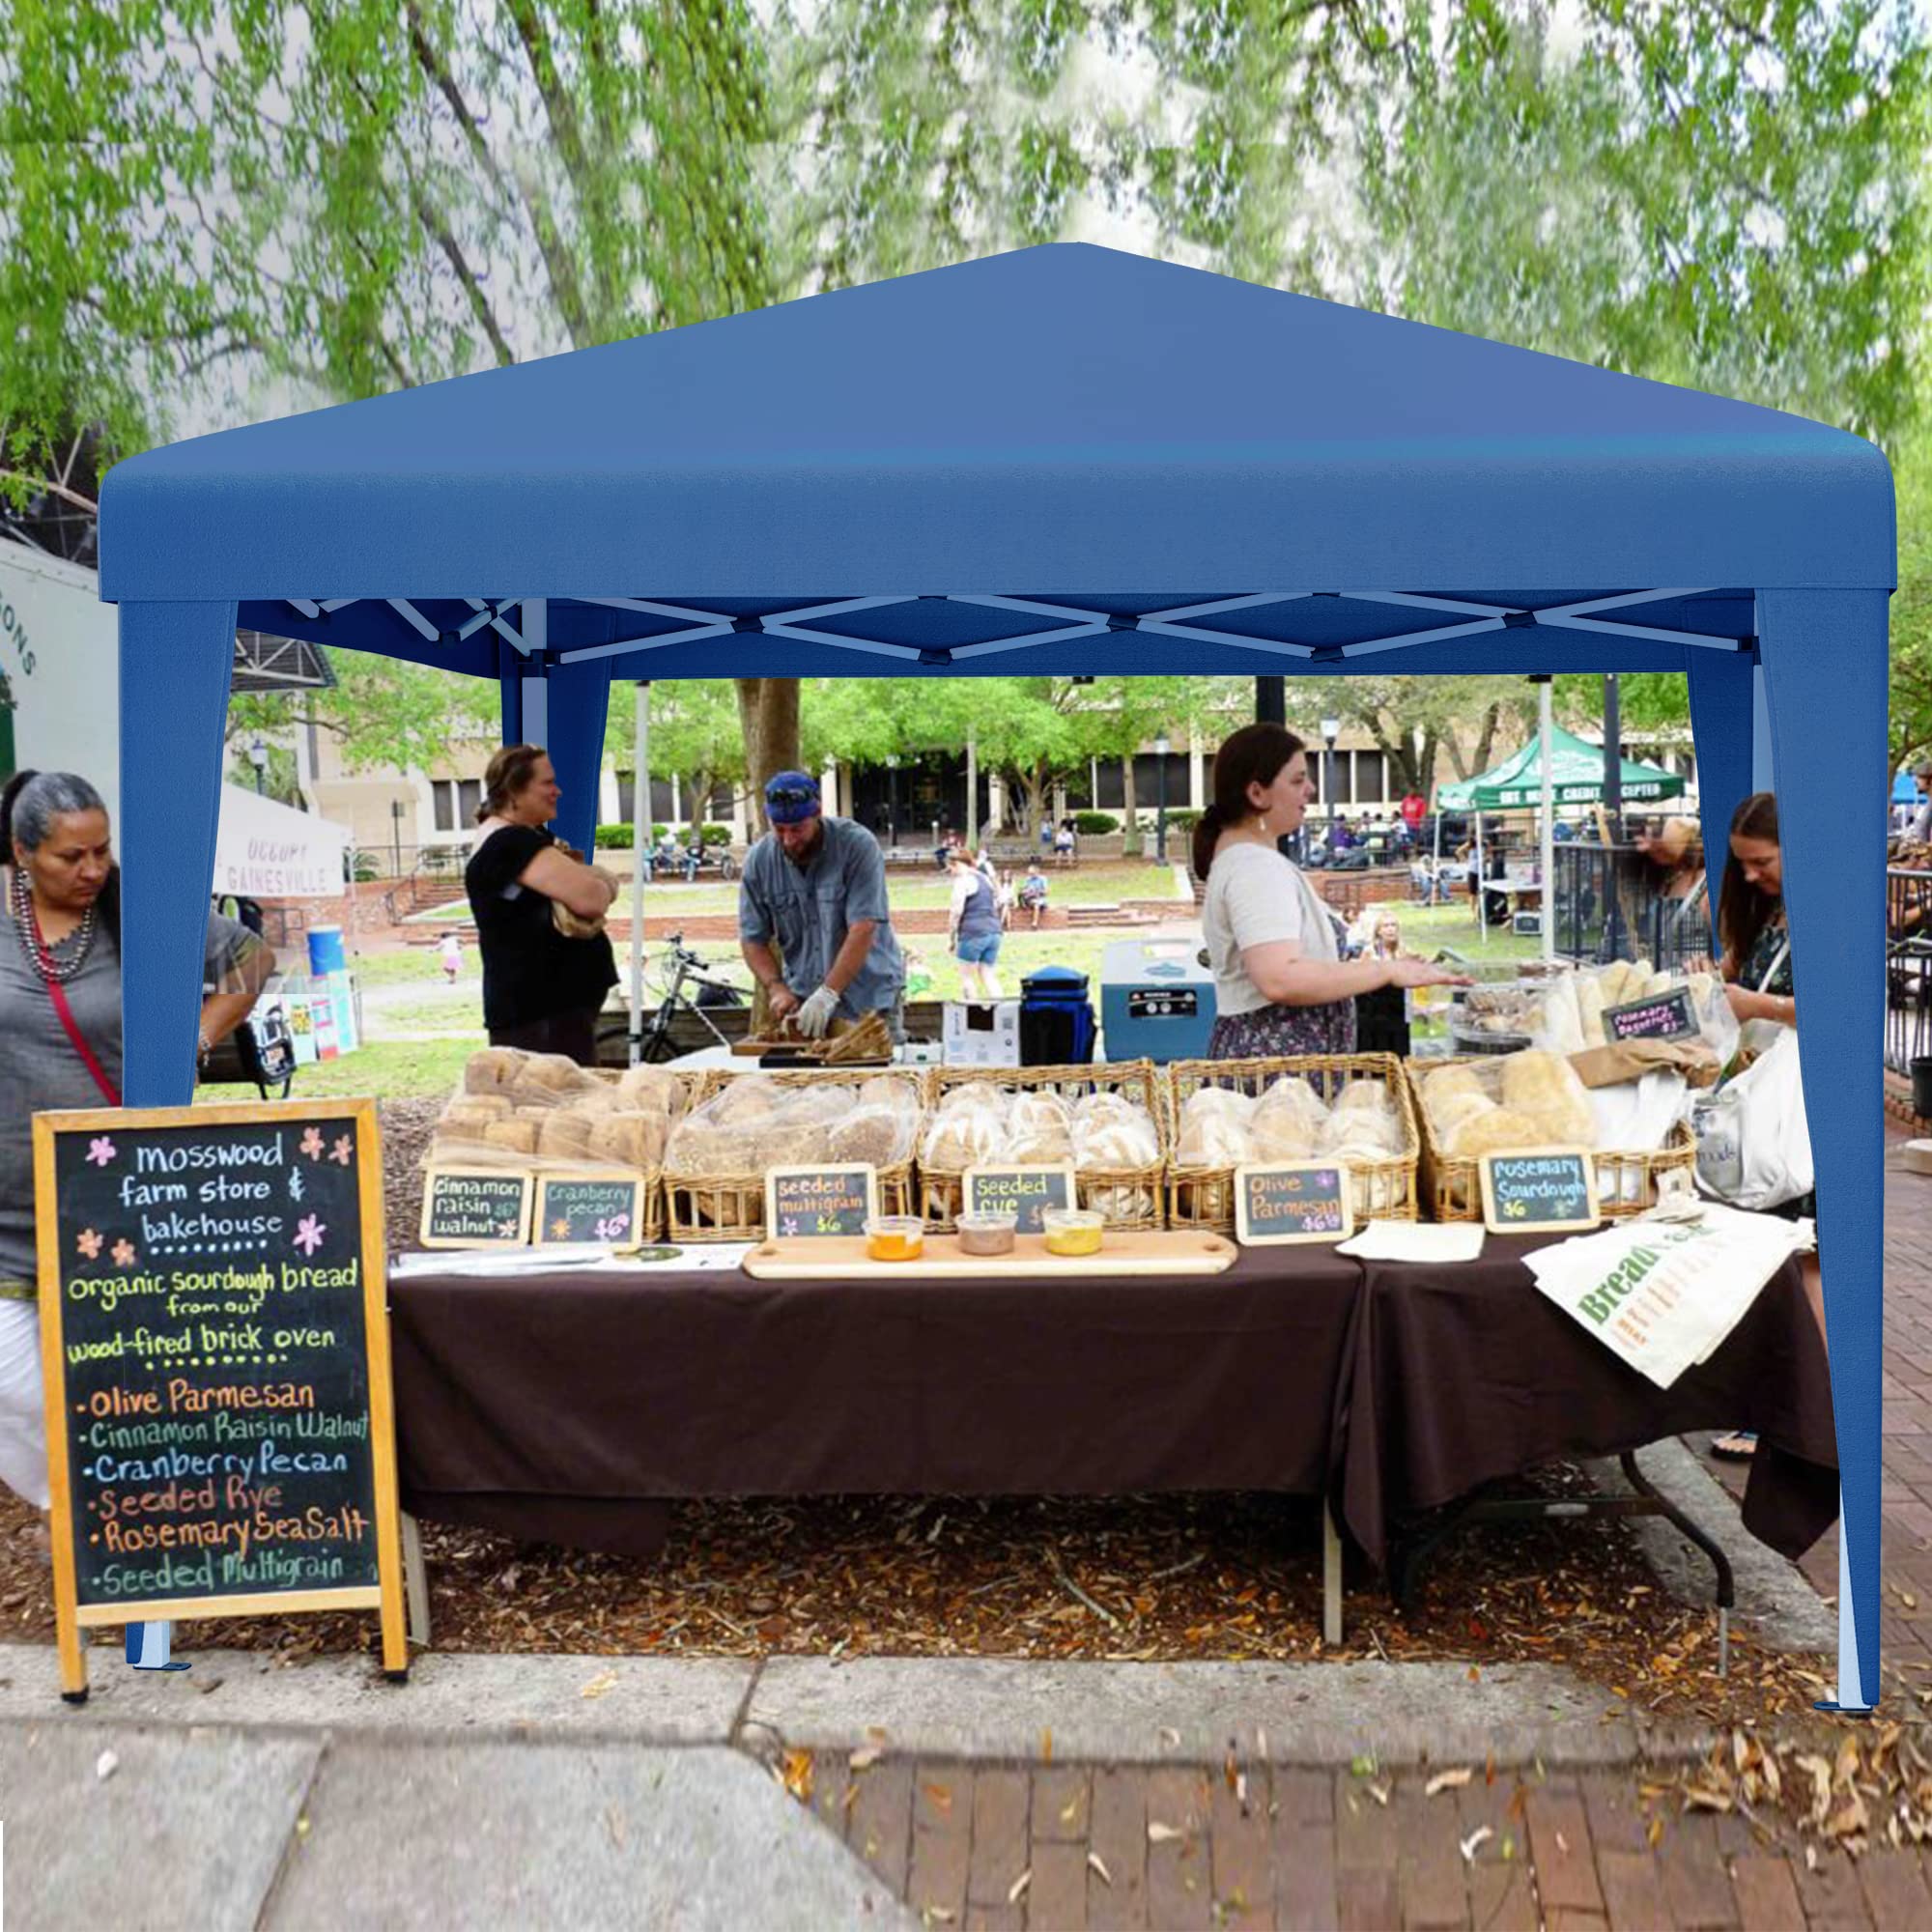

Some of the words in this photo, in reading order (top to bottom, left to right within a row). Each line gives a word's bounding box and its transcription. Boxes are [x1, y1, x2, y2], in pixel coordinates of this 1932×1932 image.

[0, 591, 36, 676] ONS
[1621, 782, 1661, 798] CEPTED
[247, 838, 307, 863] OCCUPY
[227, 867, 327, 893] GAINESVILLE
[137, 1132, 283, 1173] mosswood
[119, 1176, 187, 1208] farm
[199, 1174, 270, 1203] store
[1251, 1174, 1302, 1194] Olive
[437, 1197, 491, 1215] raisin
[566, 1204, 616, 1220] pecan
[1252, 1195, 1339, 1219] Parmesan
[142, 1211, 282, 1242] bakehouse
[435, 1215, 497, 1234] walnut
[816, 1215, 841, 1233] $6
[68, 1271, 165, 1311] organic
[173, 1263, 274, 1303] sourdough
[281, 1259, 357, 1292] bread
[1577, 1243, 1663, 1325] Bread
[166, 1296, 220, 1317] from
[225, 1298, 264, 1314] our
[68, 1325, 190, 1364] wood-fired
[201, 1323, 262, 1351] brick
[274, 1327, 334, 1349] oven
[91, 1386, 162, 1417] Olive
[169, 1378, 314, 1412] Parmesan
[90, 1421, 209, 1449] Cinnamon
[213, 1411, 290, 1442] Raisin
[296, 1410, 370, 1438] Walnut
[96, 1447, 253, 1484] Cranberry
[260, 1440, 348, 1472] Pecan
[99, 1480, 214, 1520] Seeded
[226, 1475, 283, 1512] Rye
[105, 1518, 250, 1559] Rosemary
[103, 1551, 213, 1595] Seeded
[223, 1548, 343, 1588] Multigrain
